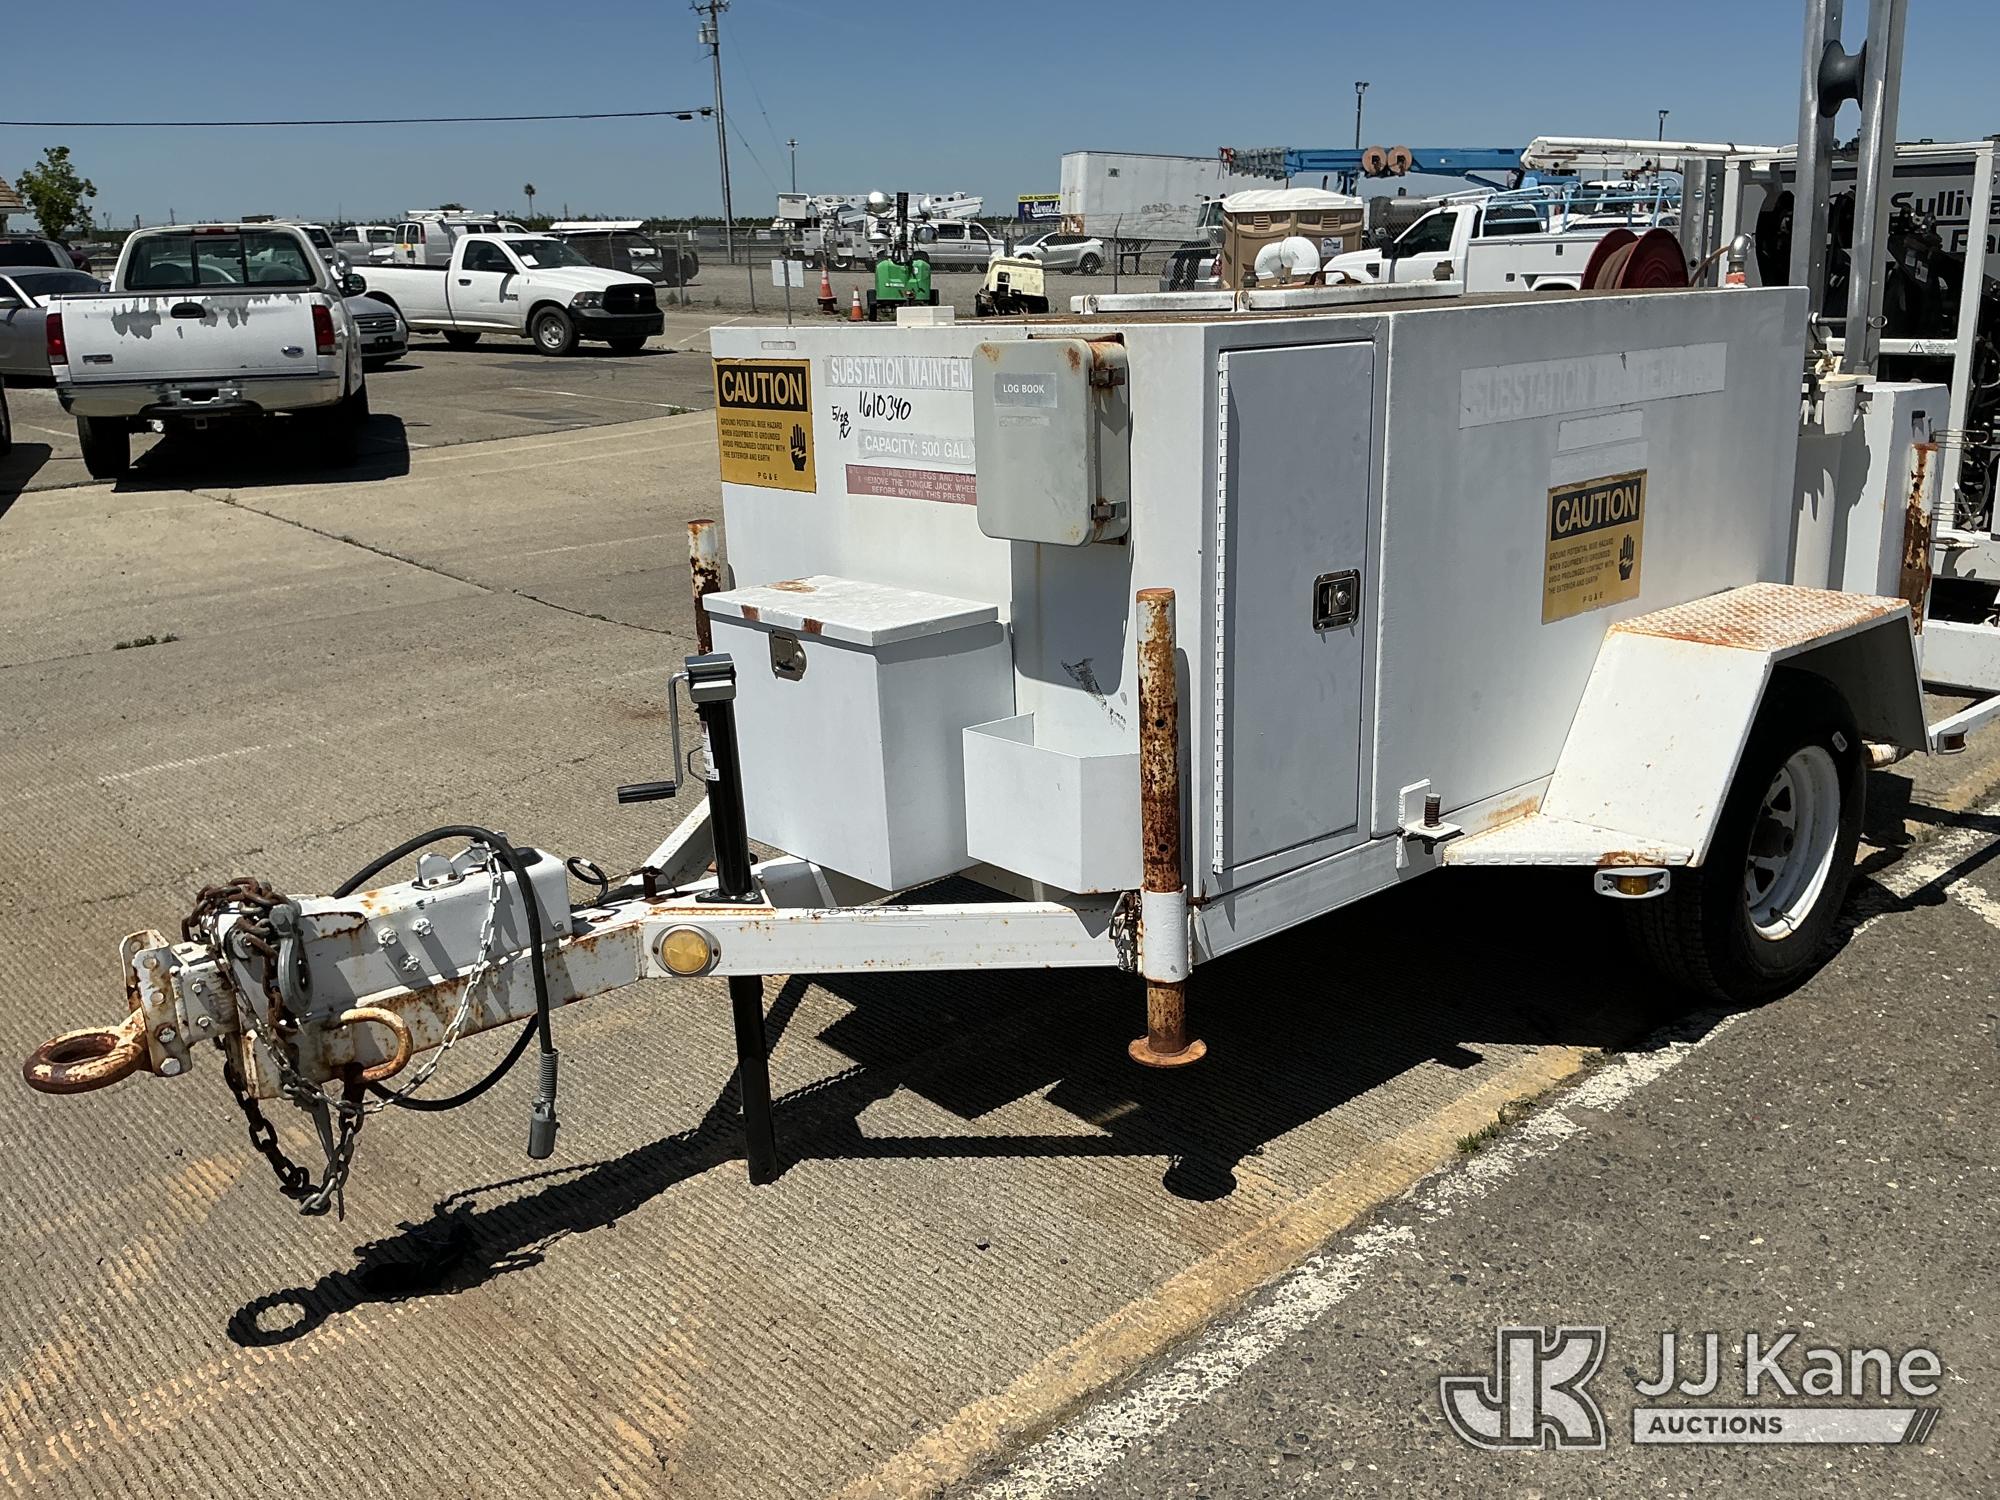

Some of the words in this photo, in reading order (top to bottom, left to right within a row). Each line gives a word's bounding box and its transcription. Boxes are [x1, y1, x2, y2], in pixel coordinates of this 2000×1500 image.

[831, 357, 904, 386] SUBSTATION
[909, 358, 972, 388] MAINTEN
[721, 370, 804, 405] CAUTION
[1003, 384, 1019, 393] LOG
[1021, 384, 1045, 394] BOOK
[859, 390, 912, 421] 1610340
[865, 435, 918, 456] CAPACITY:
[922, 441, 940, 457] 500
[944, 442, 970, 460] GAL.
[892, 478, 903, 487] THE
[906, 479, 933, 490] TONGUE
[935, 481, 953, 491] JACK
[920, 471, 937, 481] LEGS
[939, 473, 953, 483] AND
[955, 474, 976, 485] CRAN
[871, 485, 897, 495] BEFORE
[926, 490, 941, 499] THIS
[943, 492, 966, 502] PRESS
[1555, 485, 1638, 534] CAUTION
